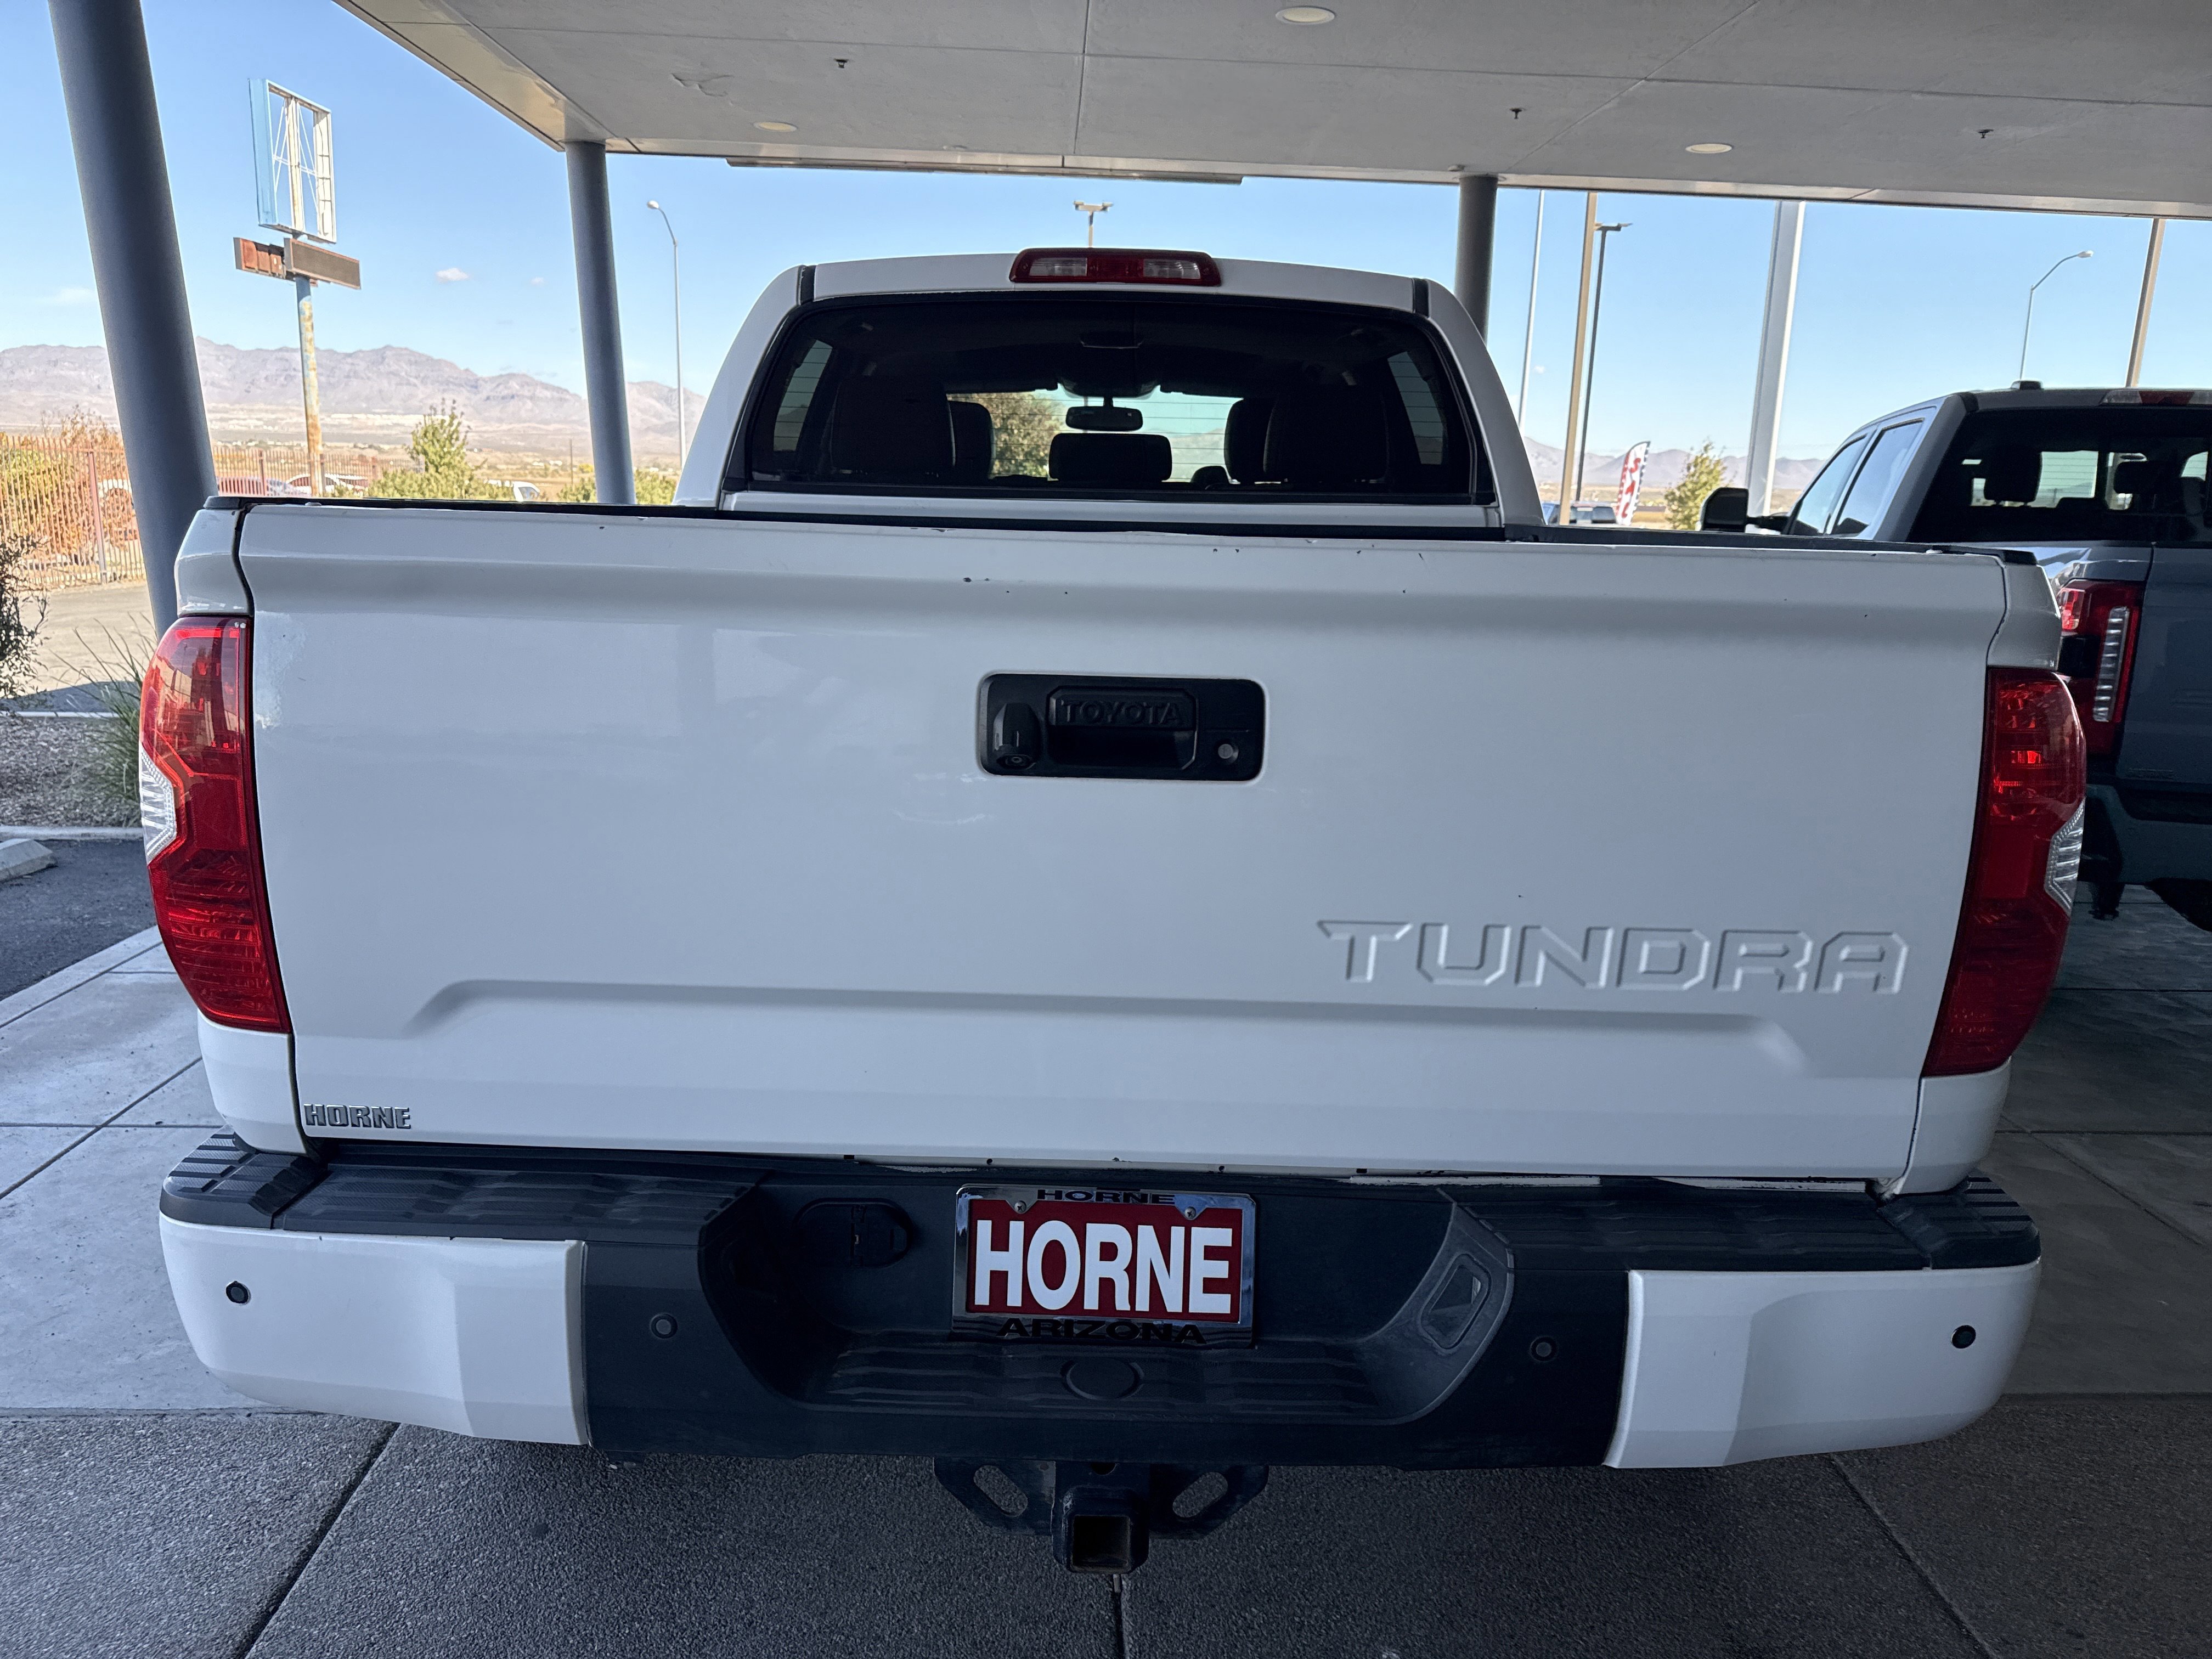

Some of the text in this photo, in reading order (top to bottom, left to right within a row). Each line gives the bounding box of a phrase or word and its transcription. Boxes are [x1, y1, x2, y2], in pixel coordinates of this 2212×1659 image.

[1060, 701, 1178, 724] TOYOTA
[1317, 920, 1909, 994] TUNDRA
[303, 1103, 411, 1128] HORNE
[1037, 1189, 1175, 1205] HORNE
[974, 1220, 1233, 1314] HORNE
[996, 1318, 1207, 1344] ARIZONA
